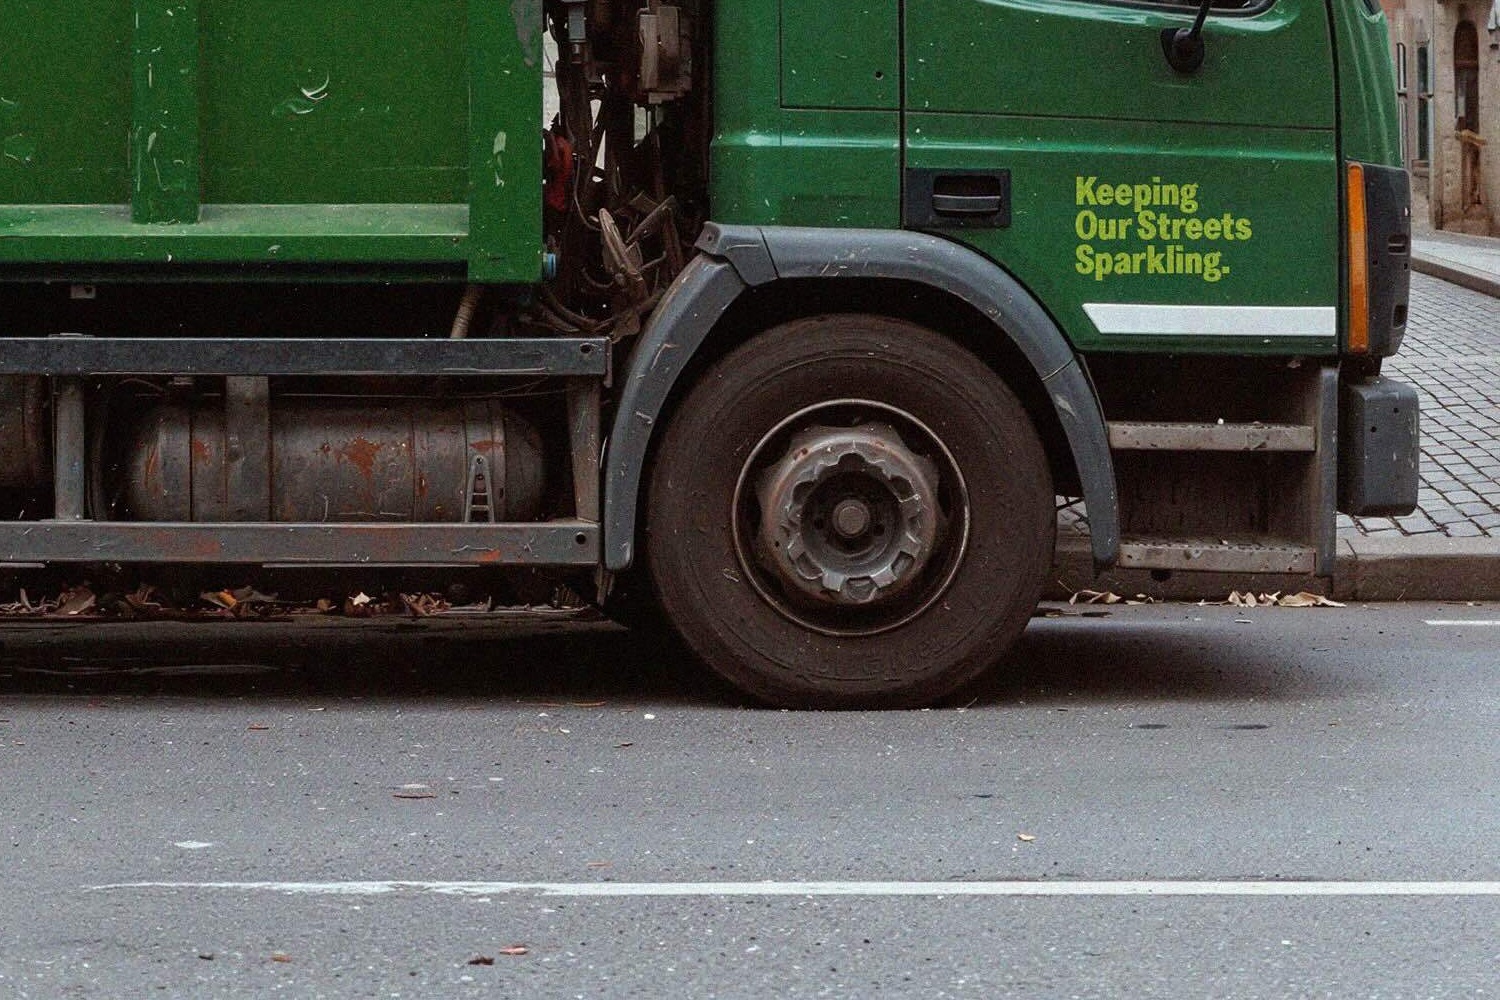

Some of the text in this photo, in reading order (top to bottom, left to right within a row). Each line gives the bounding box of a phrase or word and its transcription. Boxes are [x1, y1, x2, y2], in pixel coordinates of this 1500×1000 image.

[1075, 176, 1199, 214] Keeping
[1075, 209, 1253, 241] Our Streets
[1075, 243, 1230, 282] Sparkling.
